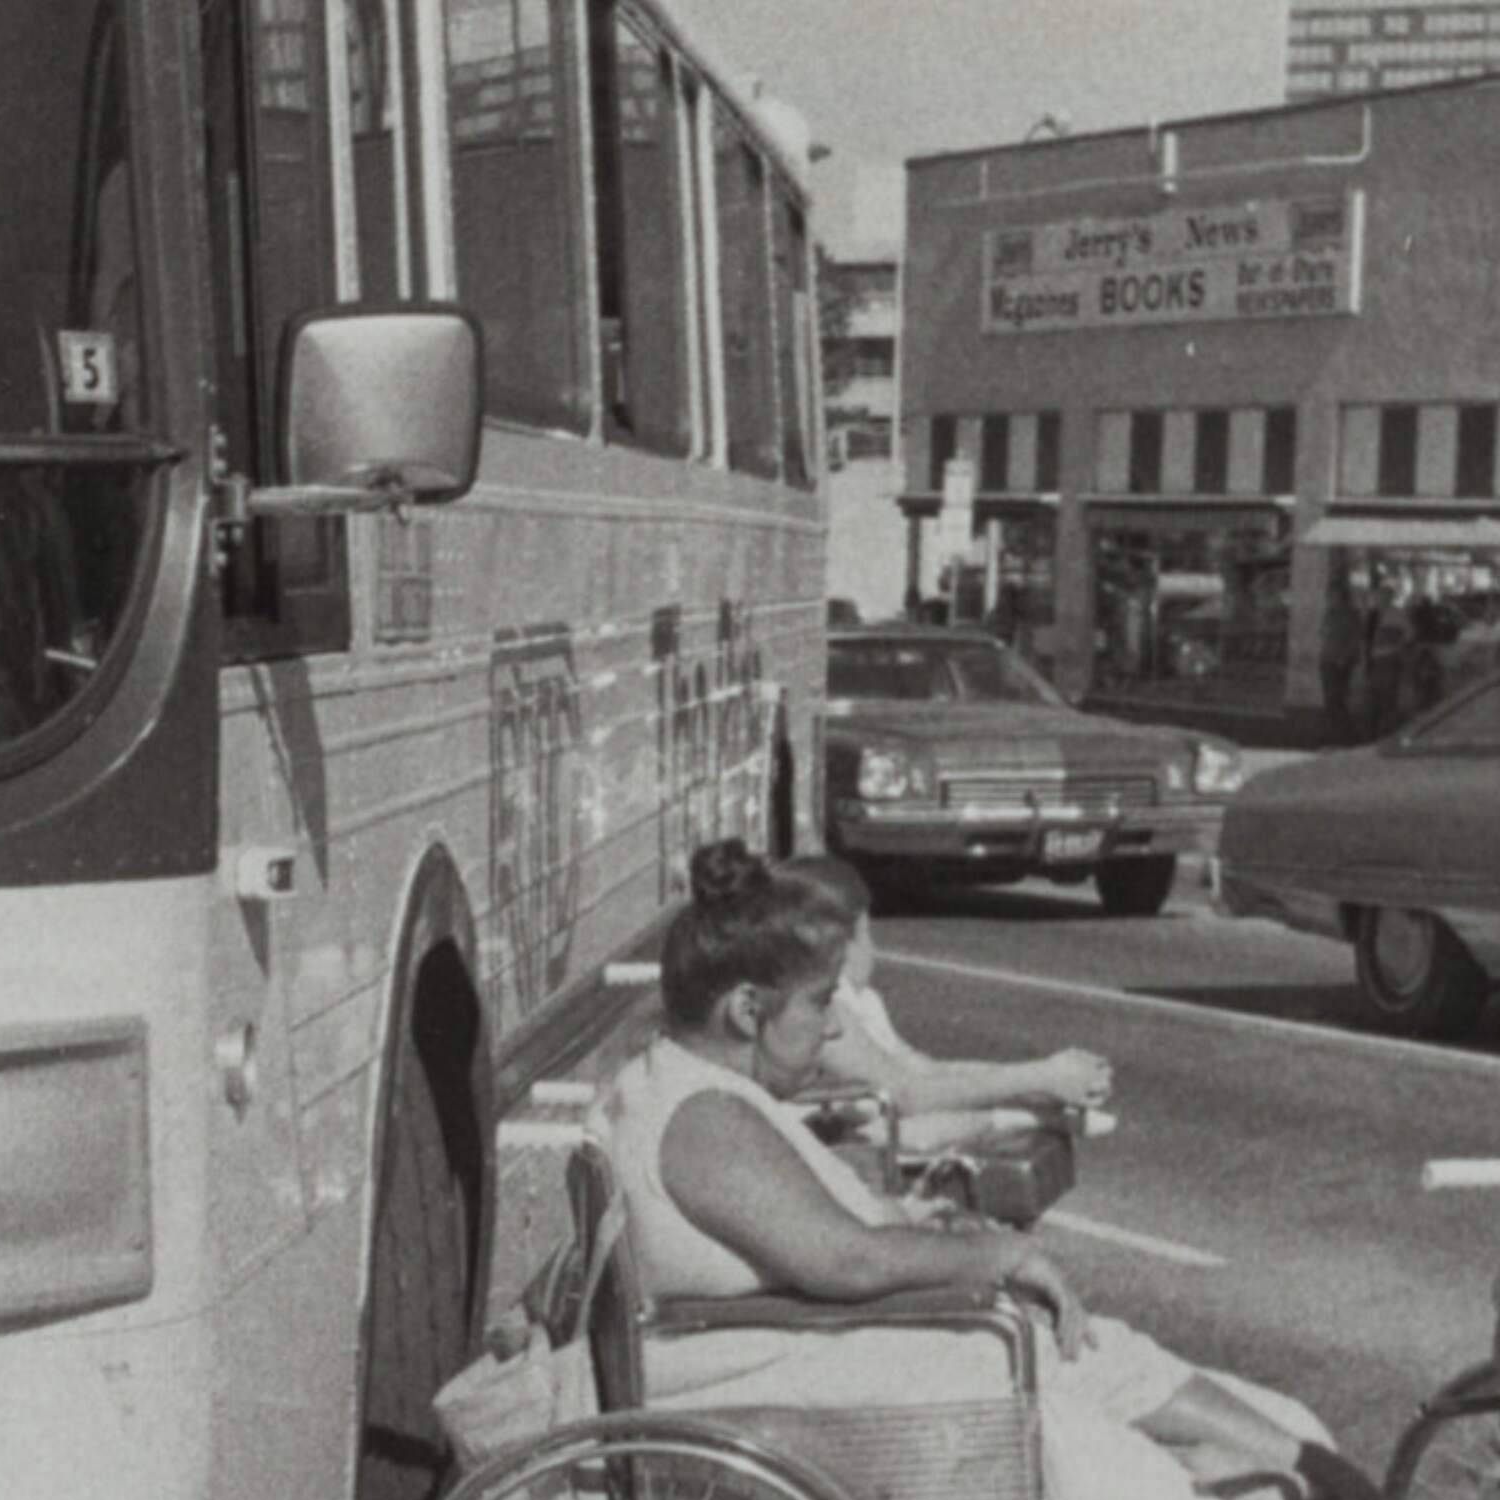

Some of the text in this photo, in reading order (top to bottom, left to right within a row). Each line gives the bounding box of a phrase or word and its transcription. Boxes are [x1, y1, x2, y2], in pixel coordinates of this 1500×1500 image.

[1064, 223, 1153, 268] Jerry's
[1184, 215, 1259, 249] News
[1100, 270, 1207, 315] BOOKS
[82, 347, 100, 390] 5
